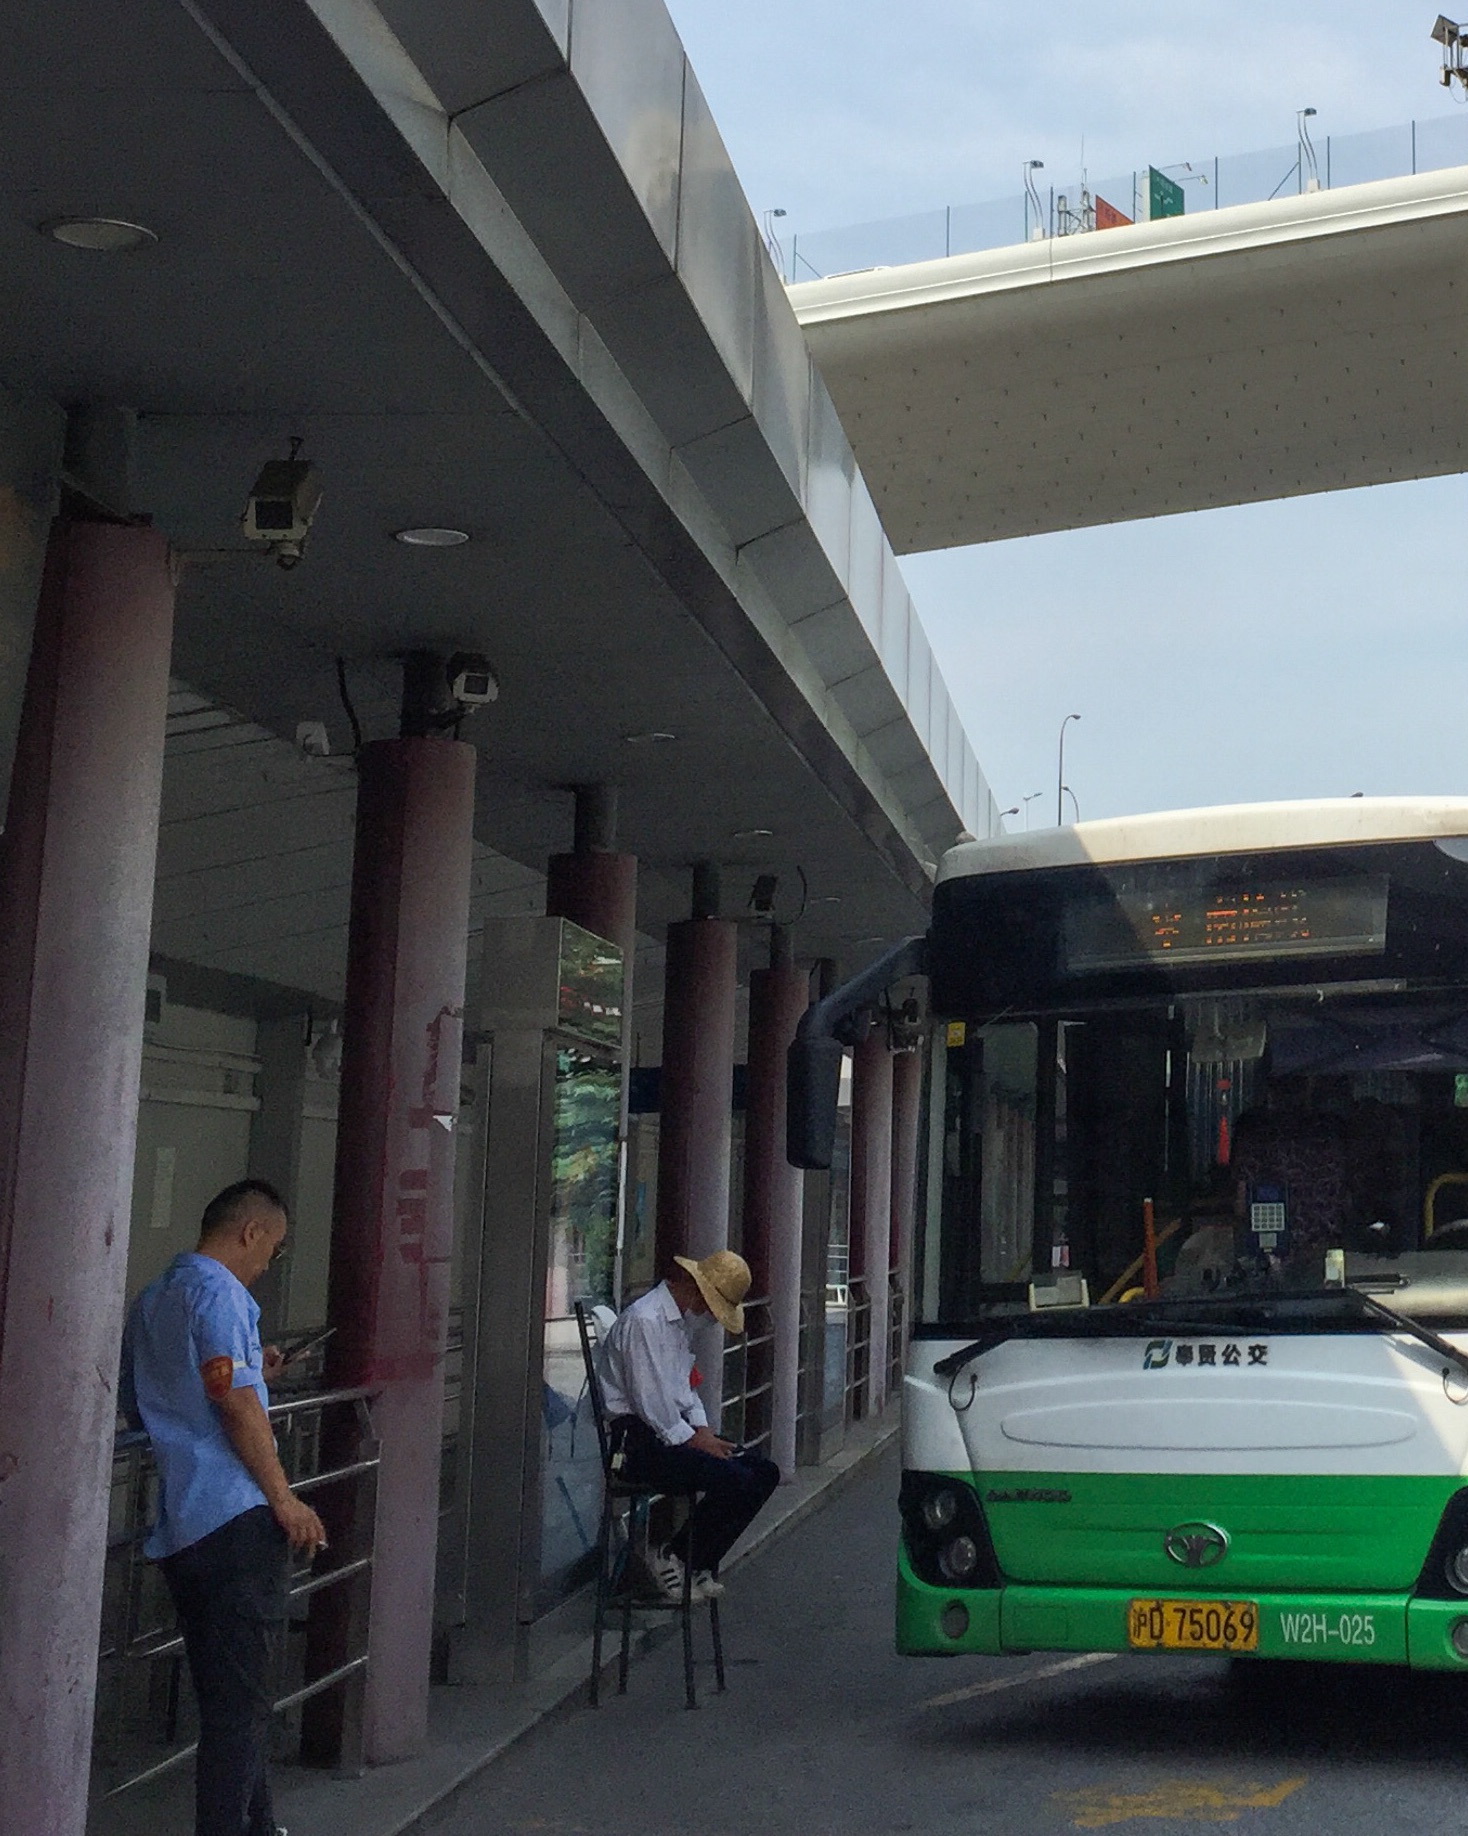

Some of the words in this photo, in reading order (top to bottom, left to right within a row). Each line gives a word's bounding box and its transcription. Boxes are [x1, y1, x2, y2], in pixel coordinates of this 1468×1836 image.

[1175, 1343, 1269, 1367] 奉贤公交
[1280, 1611, 1376, 1645] W2H-025
